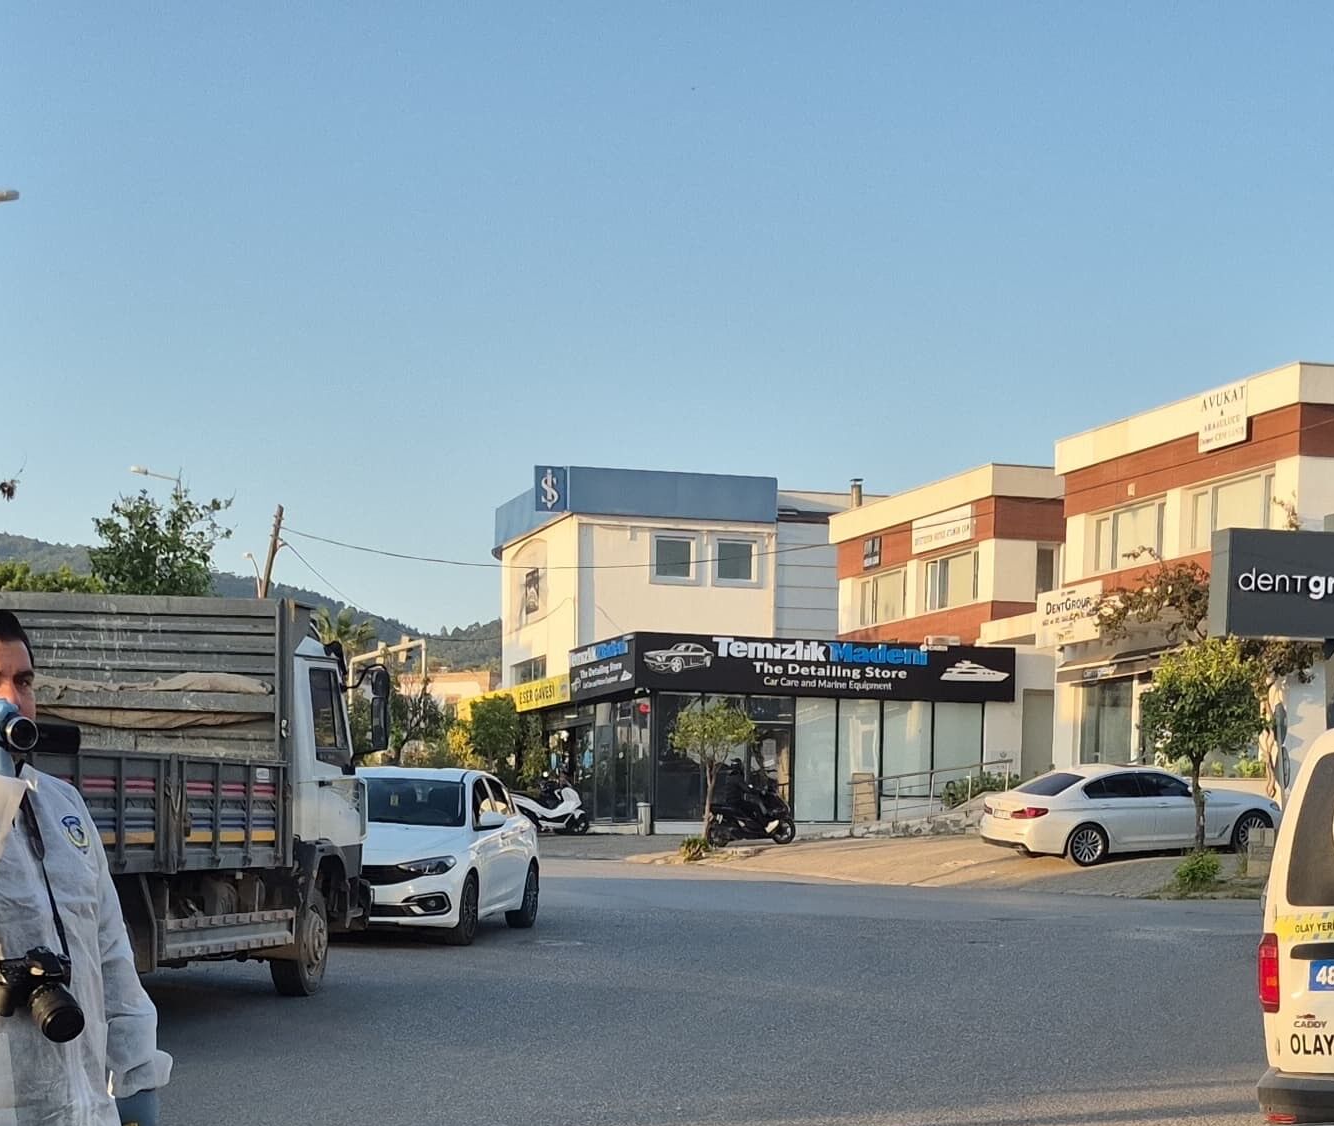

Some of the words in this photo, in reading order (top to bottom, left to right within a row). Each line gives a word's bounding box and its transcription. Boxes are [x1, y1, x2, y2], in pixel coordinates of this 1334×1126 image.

[1201, 384, 1246, 412] AVUKAT
[713, 637, 826, 661] Temizlik
[828, 642, 929, 666] Madeni
[753, 662, 784, 675] The
[788, 663, 861, 680] Detailing
[865, 666, 908, 679] Store
[763, 677, 779, 686] Car
[780, 677, 799, 687] Care
[800, 679, 816, 688] and
[818, 679, 847, 689] Marine
[849, 680, 892, 691] Equipment
[1295, 922, 1315, 933] OLAY
[1293, 1020, 1327, 1029] CADDY
[1290, 1034, 1334, 1056] OLAY
